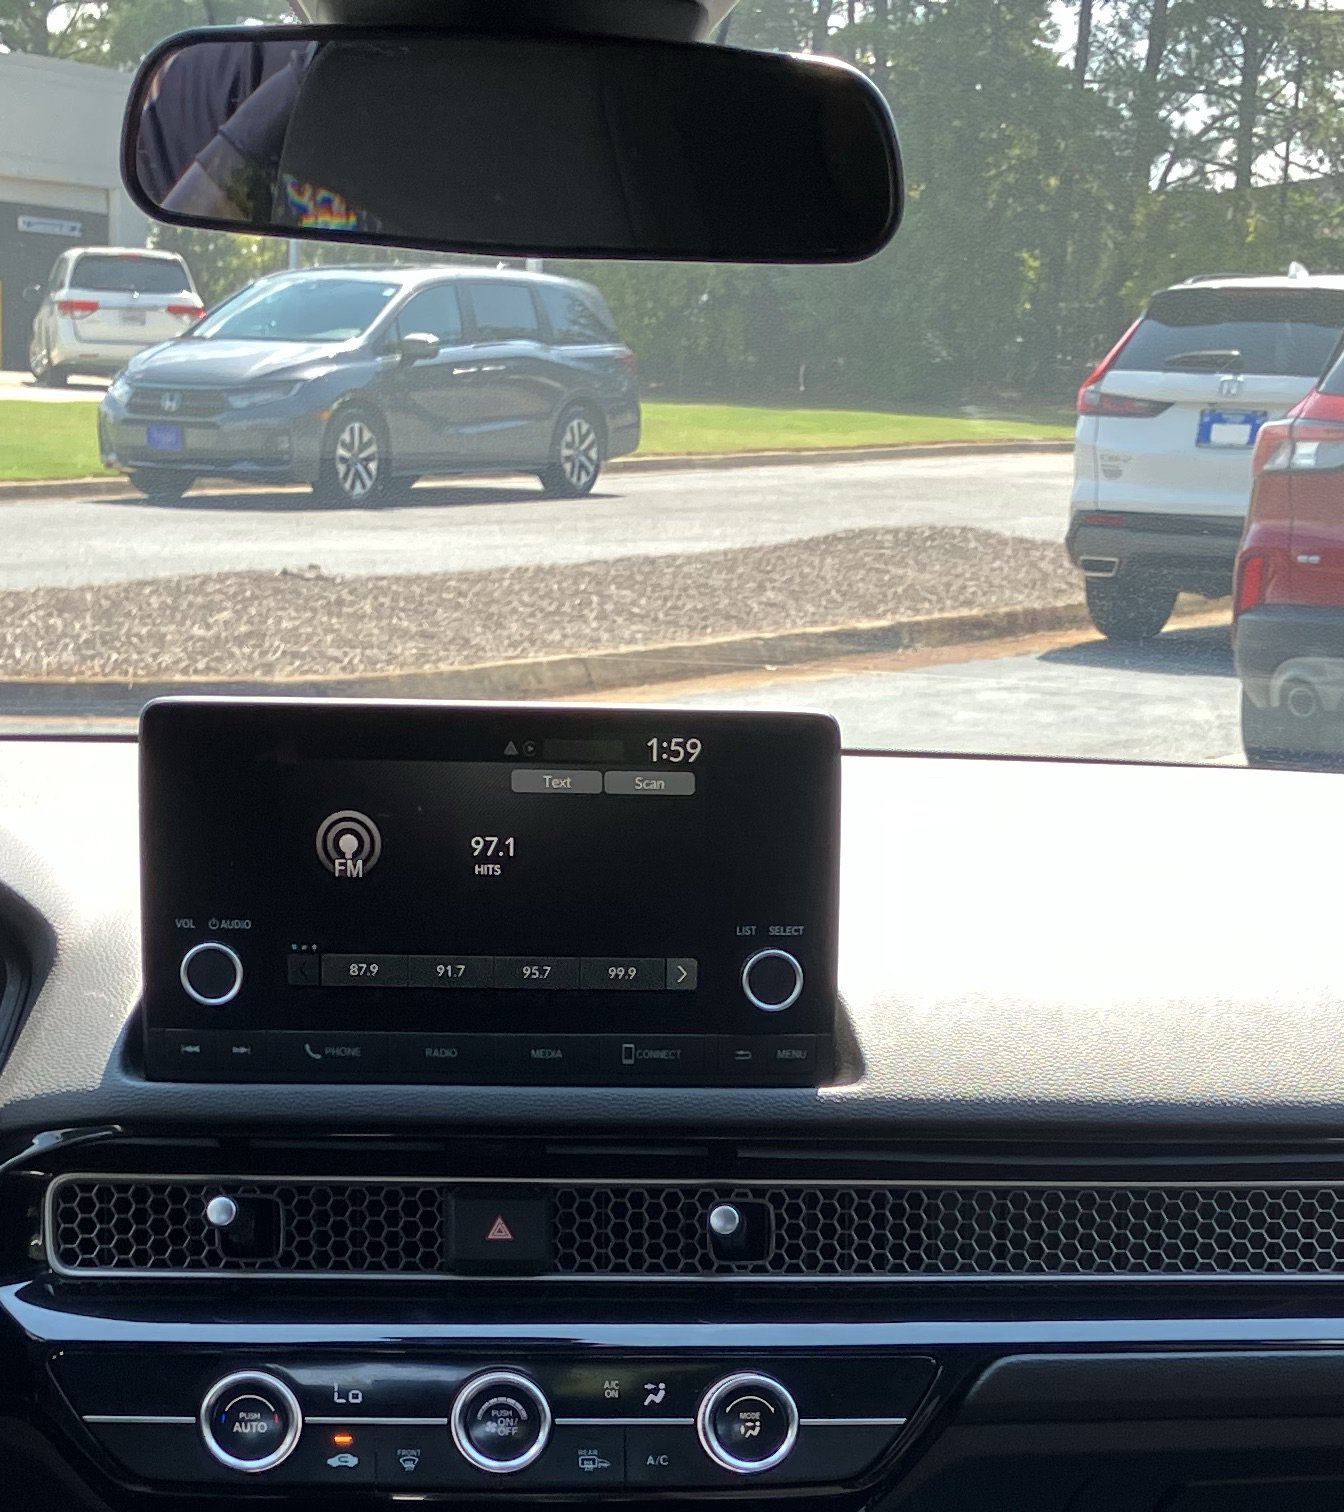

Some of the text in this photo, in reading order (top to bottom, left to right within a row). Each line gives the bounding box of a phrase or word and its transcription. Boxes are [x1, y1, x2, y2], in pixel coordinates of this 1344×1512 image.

[646, 737, 702, 763] 1:59
[543, 775, 572, 789] Text
[634, 776, 665, 790] Scan
[471, 836, 517, 857] 97.1
[334, 859, 363, 878] FM
[474, 864, 501, 876] HITS
[175, 918, 252, 930] VOL AUDIO
[736, 926, 805, 936] LIST SELECT
[349, 963, 379, 977] 87.9
[436, 965, 465, 978] 91.7
[522, 966, 551, 979] 95.7
[608, 967, 637, 980] 99.9
[325, 1047, 361, 1058] PHONE
[425, 1048, 457, 1058] RADIO
[531, 1049, 562, 1059] MEDIA
[636, 1049, 681, 1060] CONNECT
[777, 1049, 807, 1060] MENU
[603, 1380, 620, 1390] A/C
[604, 1389, 619, 1399] ON
[239, 1411, 261, 1420] PUSH
[491, 1409, 513, 1417] PUSH
[739, 1412, 760, 1420] MODE
[233, 1421, 268, 1433] AUTO
[498, 1426, 519, 1437] OFF
[646, 1454, 669, 1466] A/C
